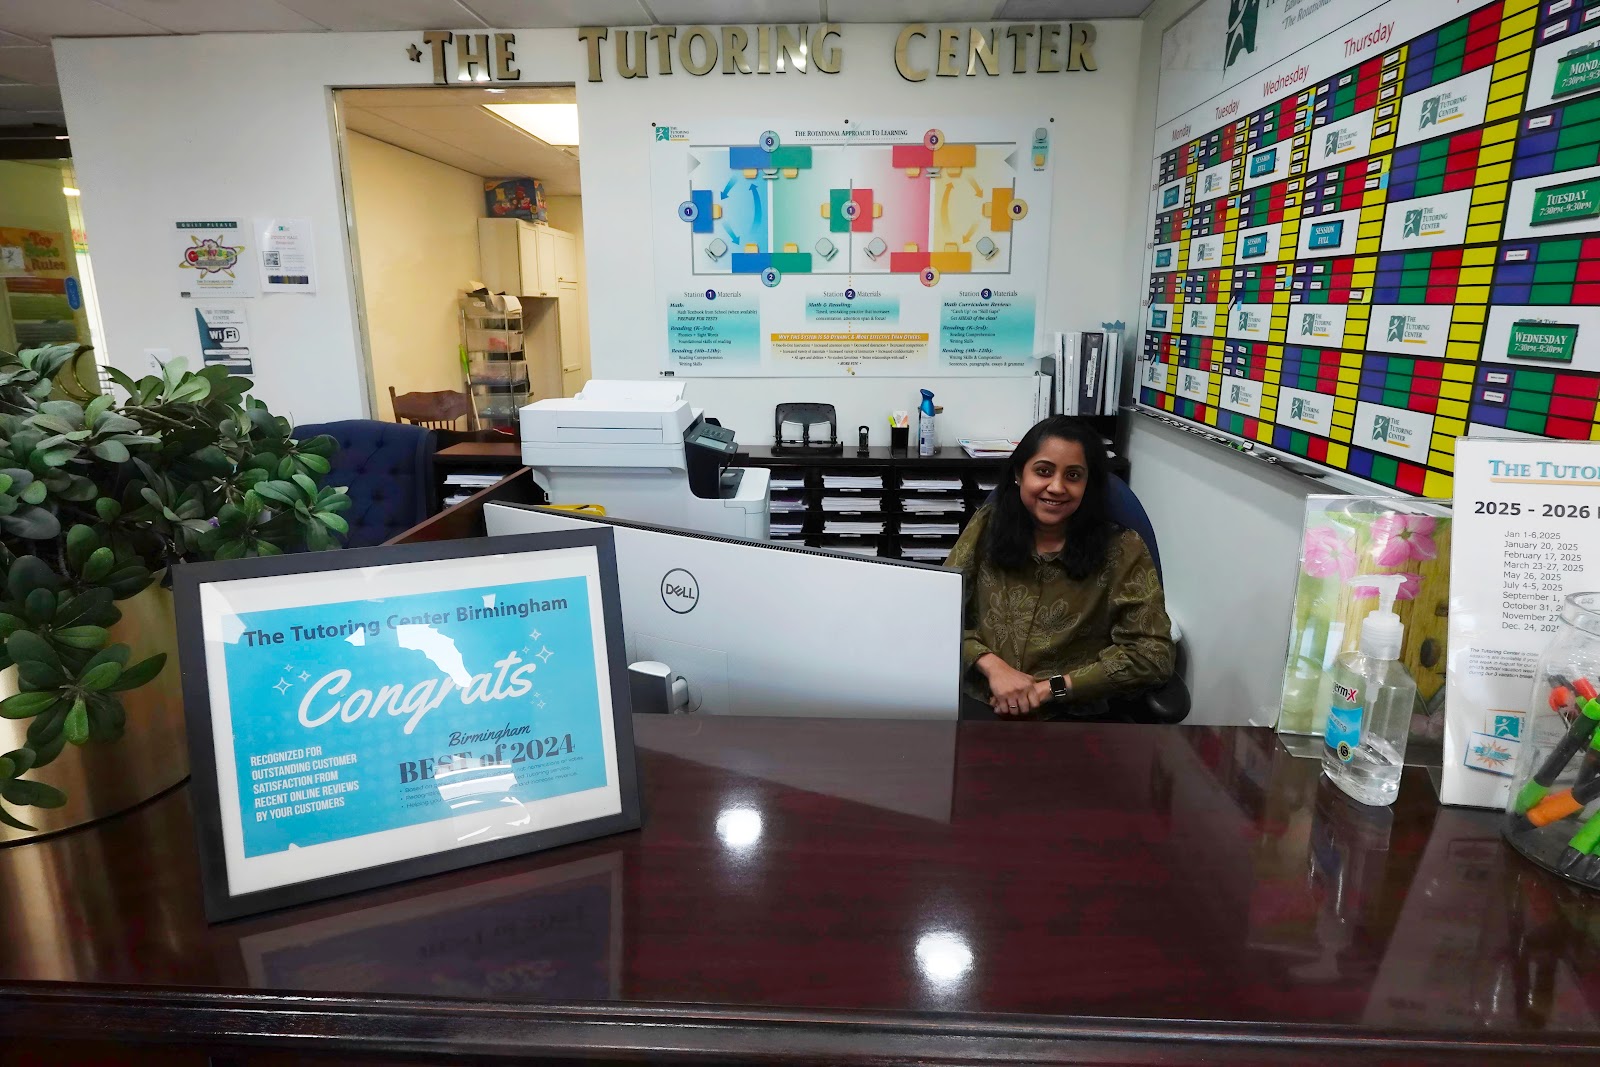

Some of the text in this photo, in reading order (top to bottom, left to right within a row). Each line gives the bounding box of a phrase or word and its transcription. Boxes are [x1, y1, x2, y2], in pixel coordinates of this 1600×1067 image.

[1344, 20, 1395, 58] Thursday
[423, 19, 1098, 85] THE TUTORING CENTER
[1569, 59, 1600, 76] MOND
[1263, 64, 1309, 97] Wednesday
[1440, 94, 1467, 108] TUTORING
[1441, 93, 1451, 101] THE
[1215, 98, 1240, 120] Tuesday
[1438, 107, 1458, 118] CENTER
[1172, 124, 1191, 141] Monday
[1338, 132, 1357, 143] TUTORING
[1337, 141, 1352, 149] CENTER
[1255, 155, 1270, 164] SESSION
[1546, 190, 1588, 206] TUESDAY
[1424, 206, 1433, 214] THE
[1539, 202, 1592, 216] 7:30PM-9:30PM
[1422, 213, 1448, 223] TUTORING
[1315, 226, 1335, 236] SESSION
[1421, 222, 1440, 231] CENTER
[1247, 238, 1261, 246] SESSION
[1317, 237, 1329, 245] FULL
[31, 258, 66, 271] Rules
[1315, 319, 1332, 327] TUTORING
[1407, 315, 1417, 323] THE
[1405, 322, 1430, 331] TUTORING
[1404, 331, 1423, 339] CENTER
[1515, 332, 1567, 345] WEDNESDAY
[1514, 343, 1563, 354] 7:30PM-9:30PM
[1391, 417, 1400, 425] THE
[1389, 425, 1412, 436] TUTORING
[1388, 432, 1406, 442] CENTER
[1488, 459, 1600, 480] THE TUTO
[1474, 501, 1521, 516] 2025
[1542, 503, 1591, 519] 2026
[1504, 540, 1579, 551] January 20, 2025
[1504, 550, 1582, 562] February 17, 2025
[1503, 560, 1584, 572] March 23-27, 2025
[1503, 571, 1562, 581] May 26, 2025
[666, 583, 695, 599] DELL
[1502, 580, 1563, 591] July 4-5, 2025
[1502, 591, 1549, 602] September
[1502, 601, 1553, 612] October 31,
[1502, 611, 1546, 620] November
[243, 596, 568, 648] The Tutoring Center Birmingham
[1502, 621, 1520, 630] Dec.
[1524, 623, 1537, 632] 24,
[298, 649, 537, 735] Congrats
[448, 722, 532, 748] Birmingham
[250, 746, 322, 766] RECOGNIZED FOR
[399, 750, 474, 785] BEST
[511, 733, 576, 764] 2024
[251, 753, 358, 780] OUTSTANDING CUSTOMER
[253, 770, 339, 794] SATISFACTION FROM
[254, 780, 359, 808] RECENT ONLINE REVIEWS
[256, 796, 345, 822] BY YOUR CUSTOMERS
